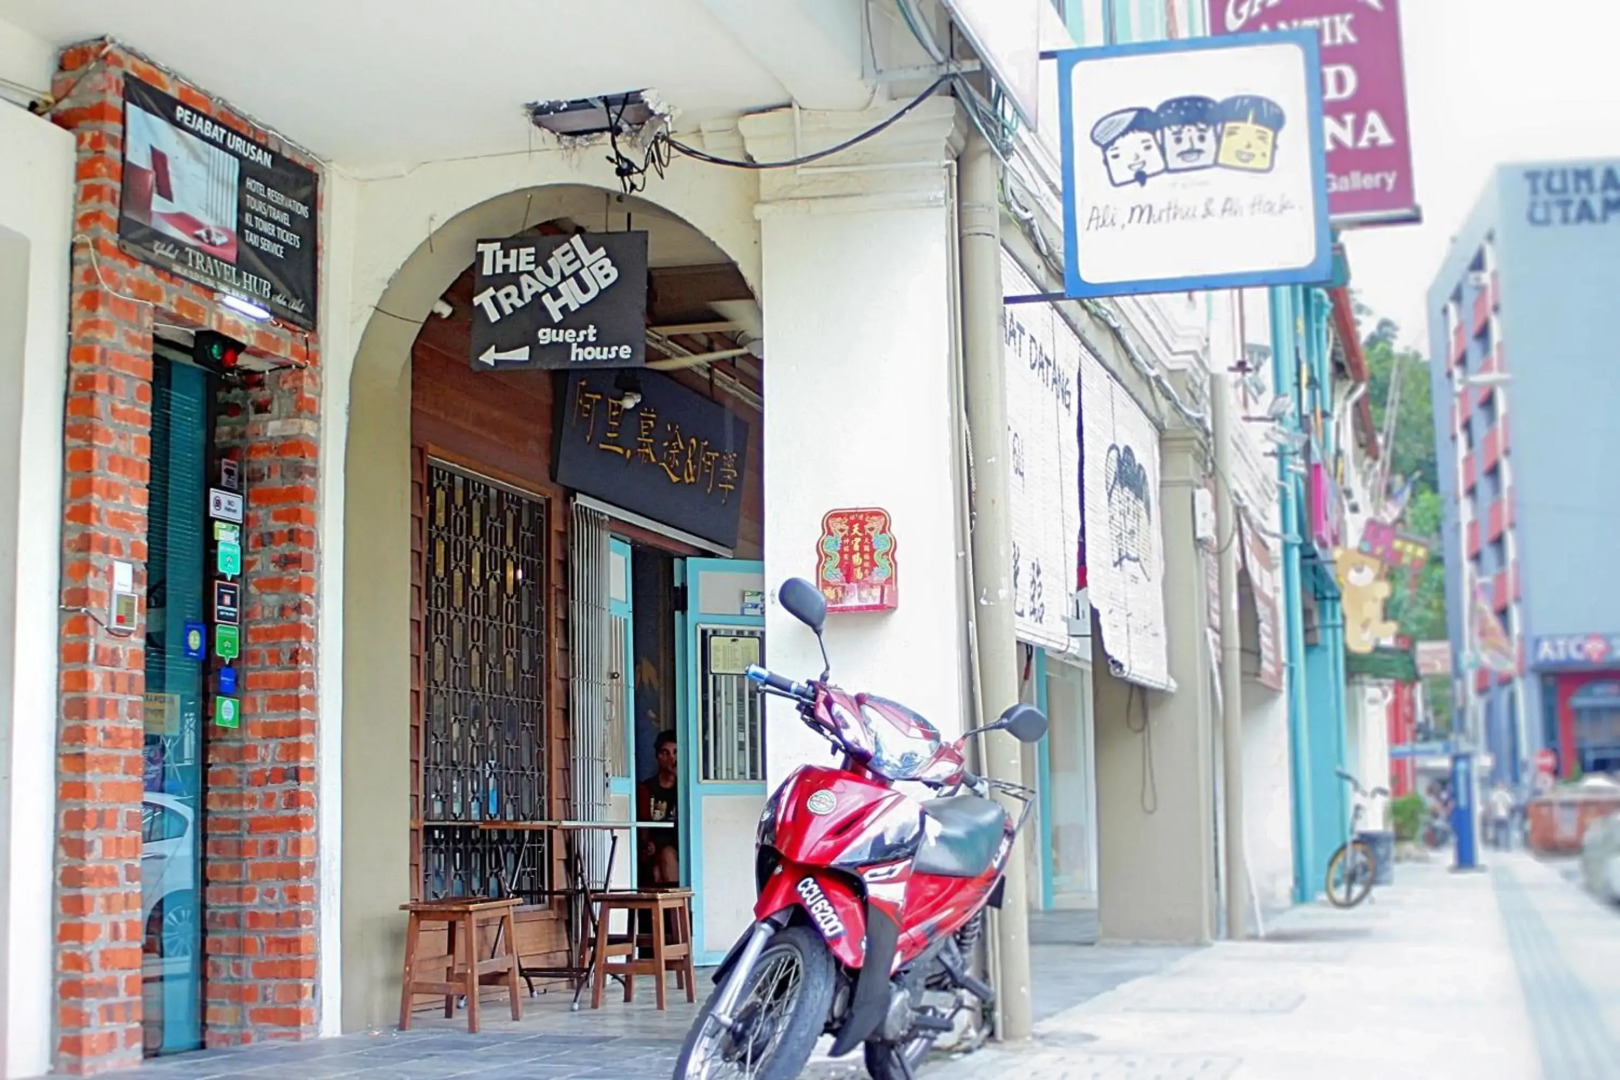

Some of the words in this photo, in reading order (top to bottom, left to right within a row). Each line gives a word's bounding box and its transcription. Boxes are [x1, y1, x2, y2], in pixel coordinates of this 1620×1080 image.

[175, 105, 227, 145] PEJABAT
[226, 131, 273, 170] URUSAN
[245, 176, 267, 198] HOTEL
[266, 187, 309, 218] RESERVATIONS
[245, 194, 291, 227] TOURS/TRAVEL
[254, 215, 276, 237] TOWER
[276, 226, 301, 249] TICKETS
[1086, 205, 1125, 231] Ali,
[244, 229, 260, 248] TAXI
[260, 236, 284, 260] SERVICE
[477, 242, 536, 276] THE
[185, 246, 241, 287] TRAVEL
[241, 270, 272, 299] HUB
[472, 233, 607, 324] TRAVEL
[541, 257, 619, 324] HUB
[537, 324, 598, 345] guest
[570, 342, 632, 362] house
[1029, 333, 1072, 416] DATANG
[797, 876, 845, 937] CCU6200
